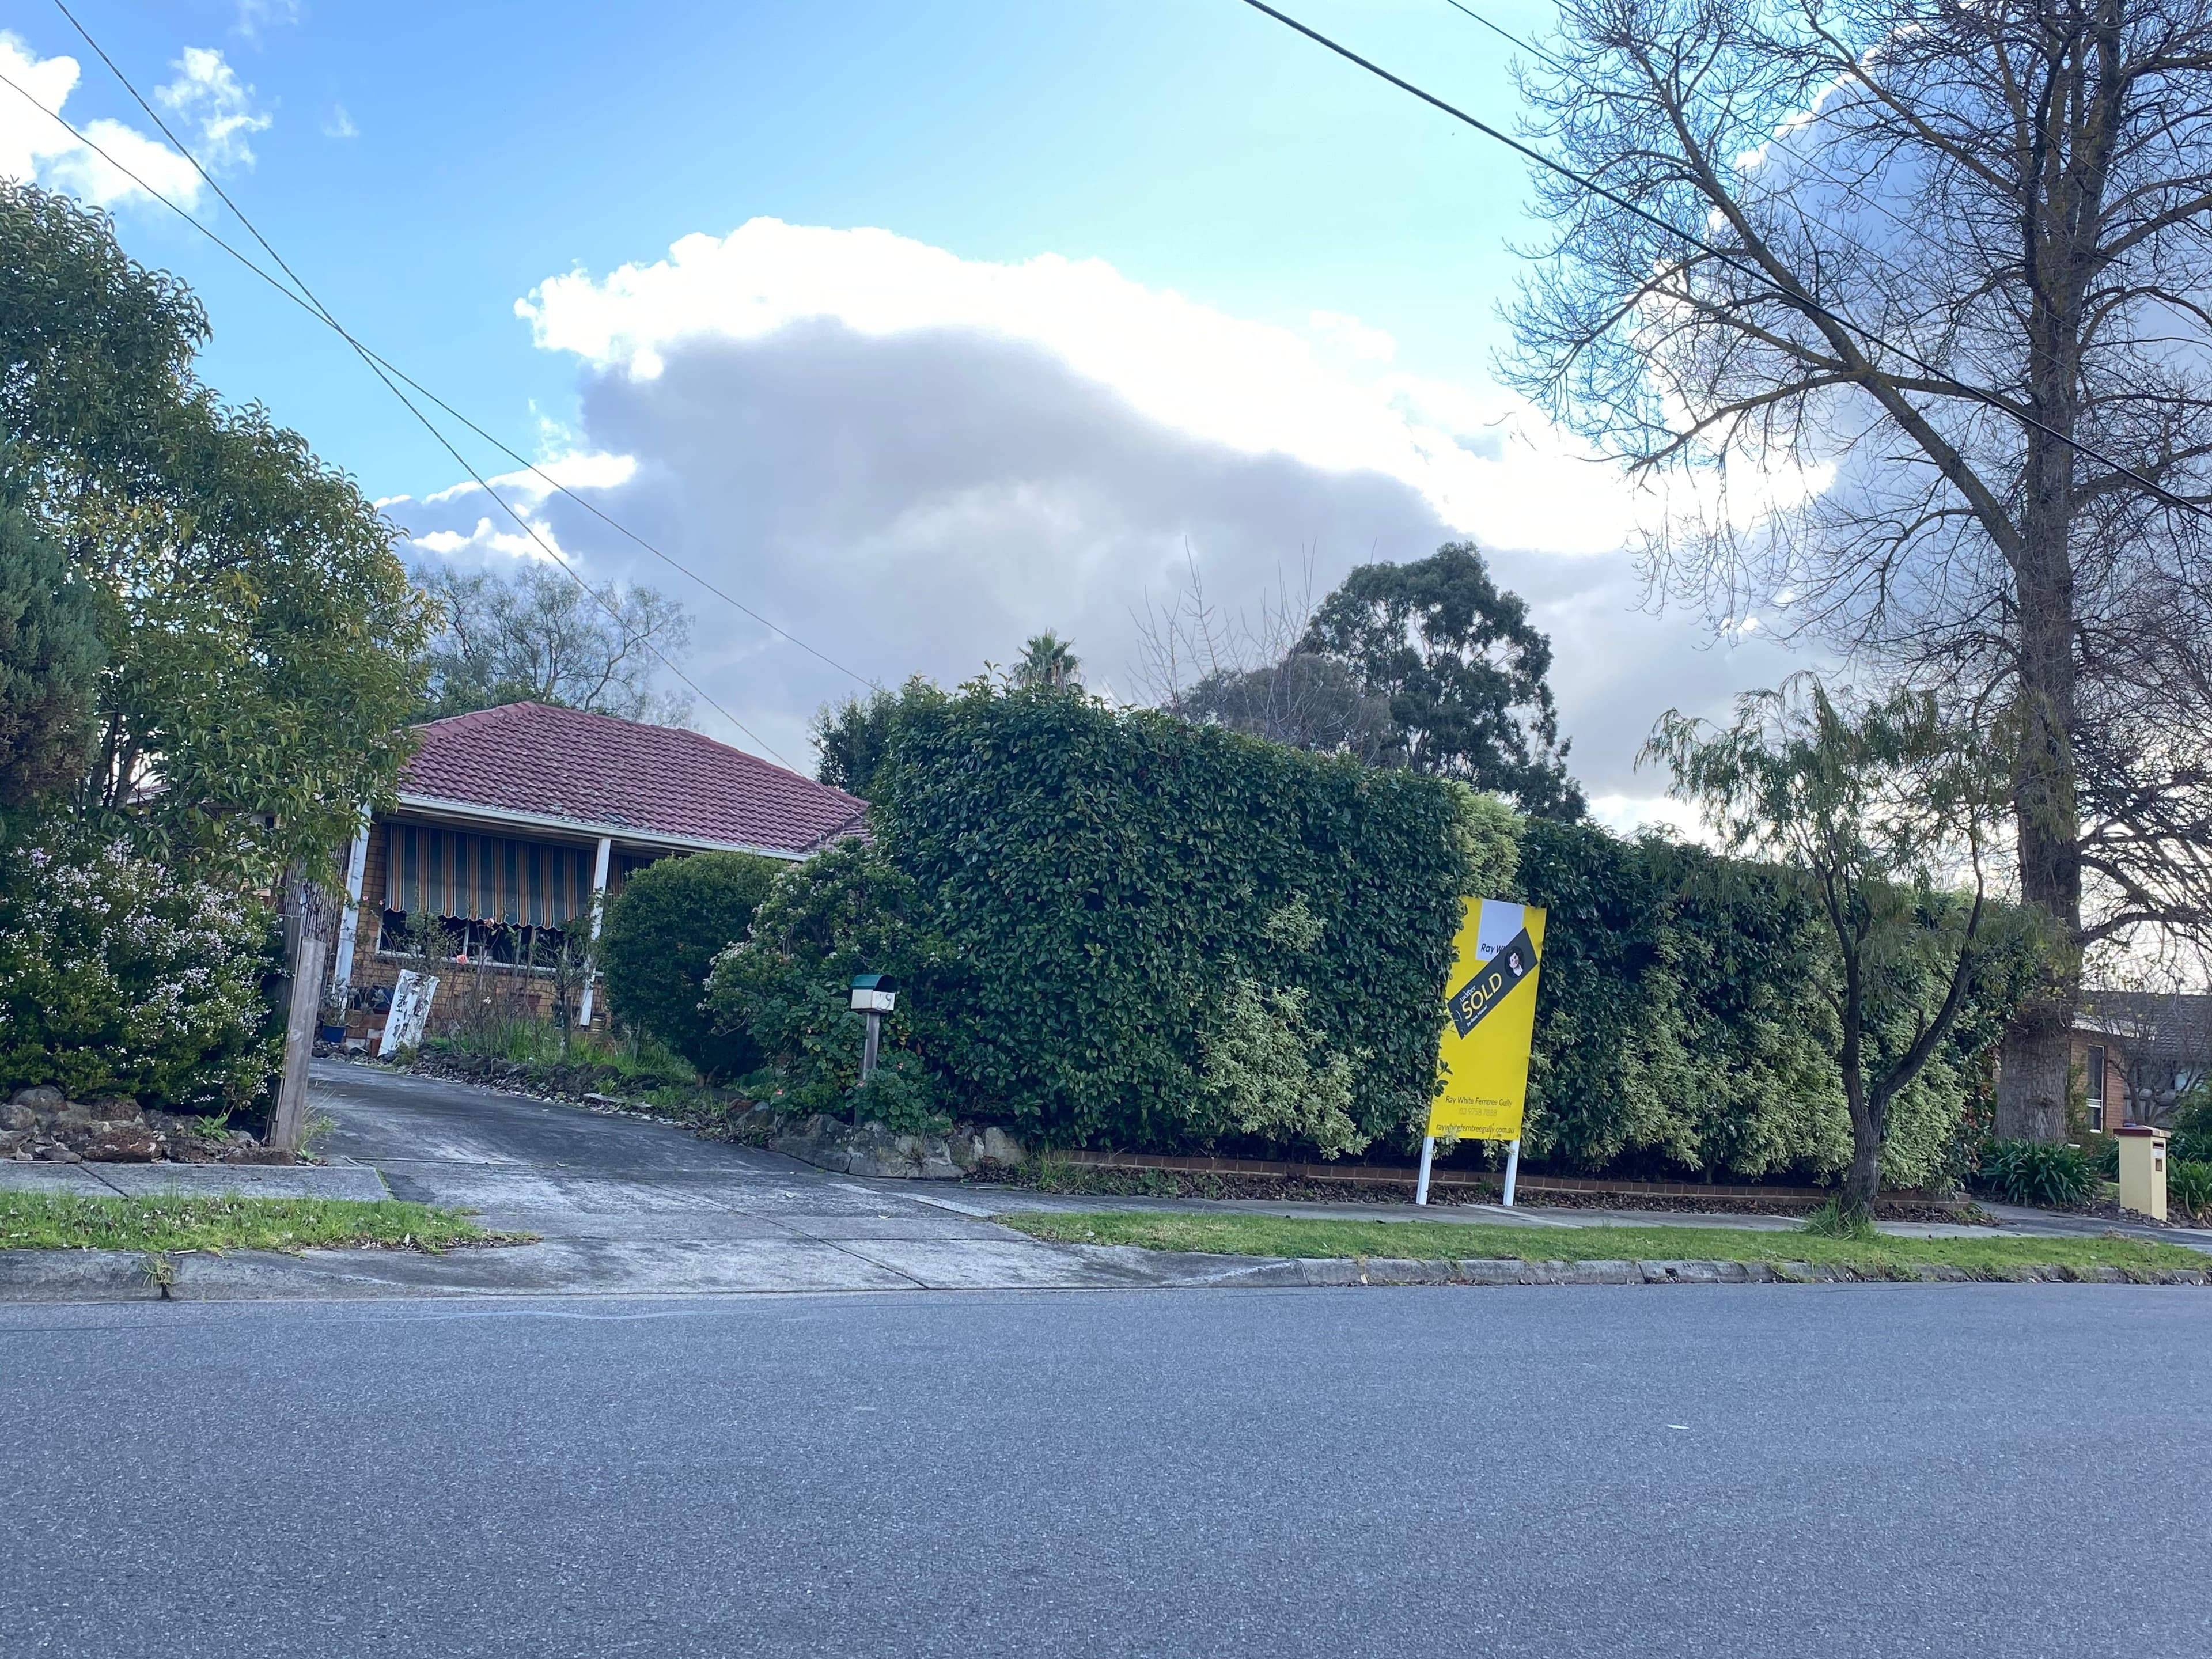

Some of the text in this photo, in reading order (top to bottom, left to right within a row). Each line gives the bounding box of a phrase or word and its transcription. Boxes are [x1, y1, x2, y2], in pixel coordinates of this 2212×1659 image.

[1481, 943, 1495, 955] Ray
[1462, 972, 1502, 1020] SOLD
[1446, 1096, 1512, 1108] Ray White Ferntree Gully
[1436, 1123, 1514, 1134] raywhiteferntreegullycom.au
